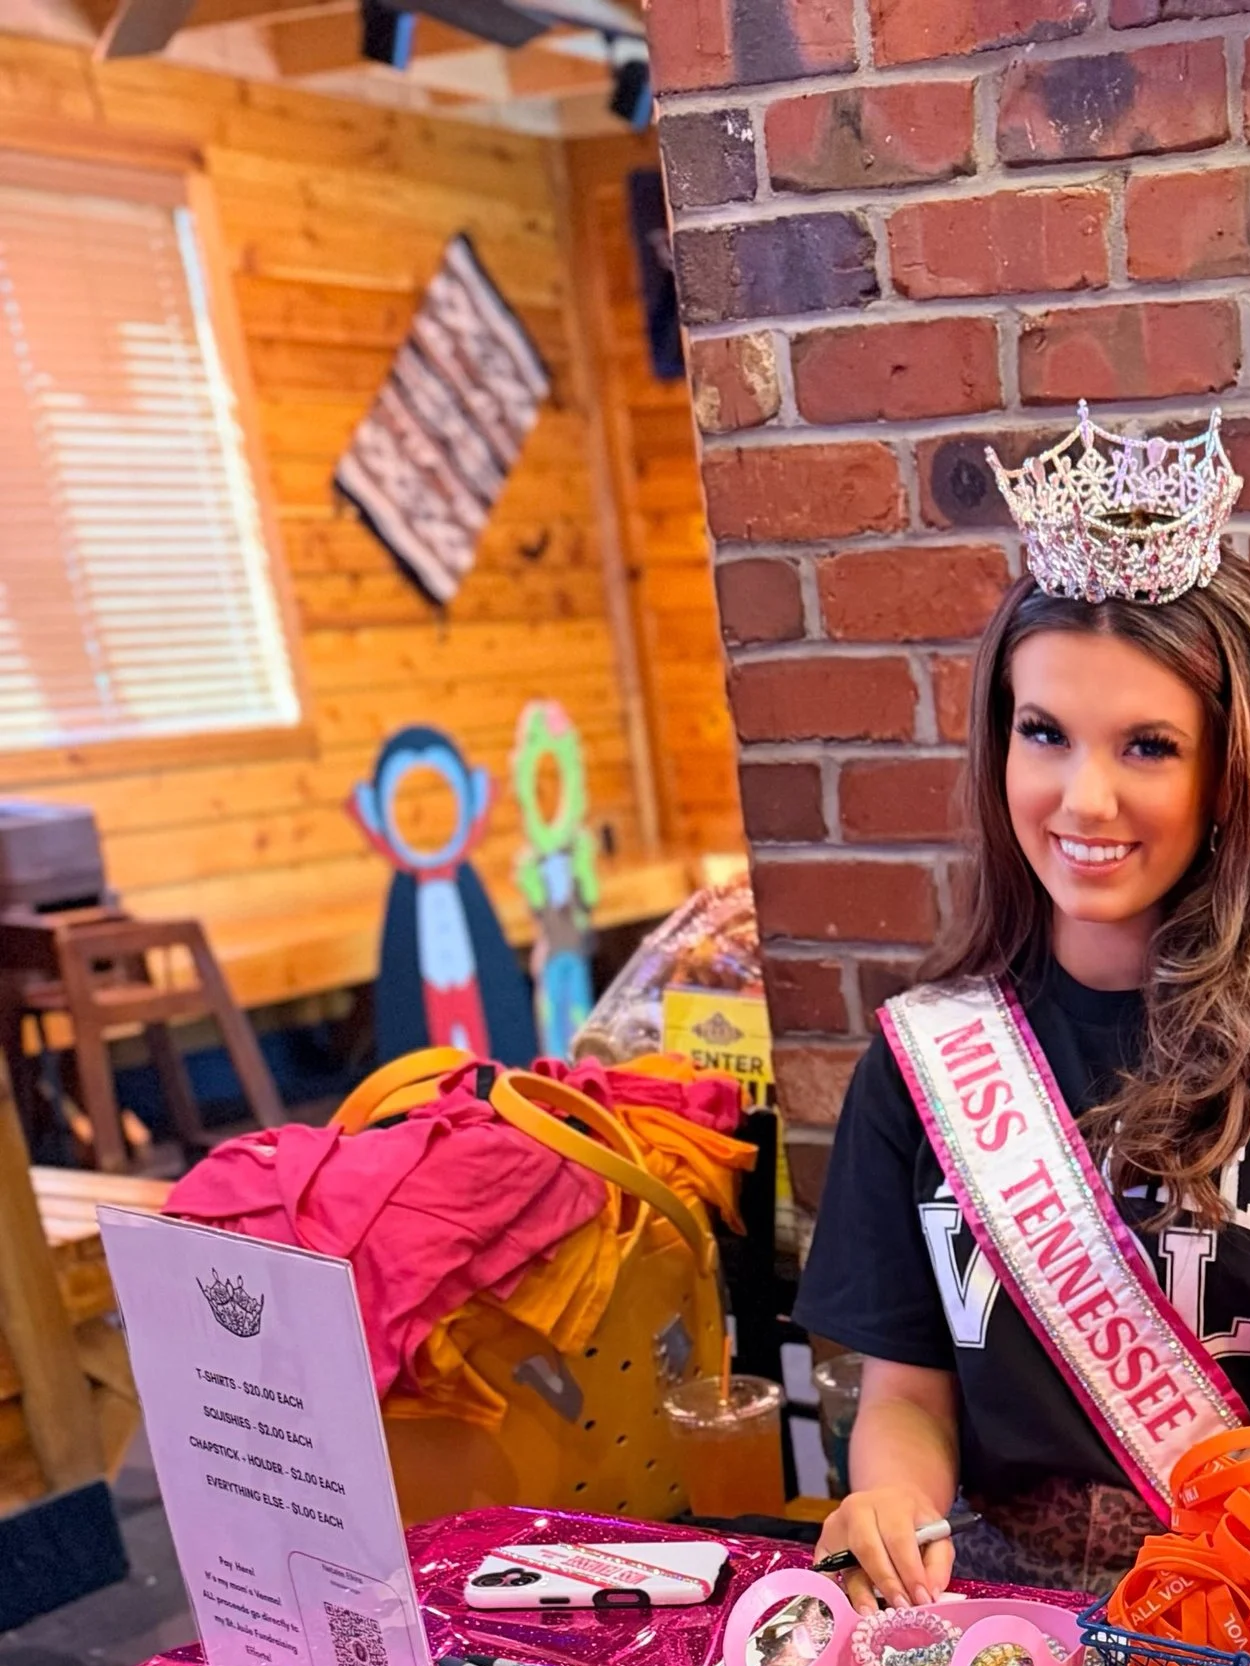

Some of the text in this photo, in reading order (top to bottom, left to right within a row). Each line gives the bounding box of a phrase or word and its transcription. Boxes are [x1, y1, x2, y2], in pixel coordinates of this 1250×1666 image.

[691, 1050, 764, 1076] ENTER
[934, 1018, 1029, 1153] MISS
[1000, 1158, 1199, 1445] TENNESSEE
[195, 1368, 236, 1390] T-SHIRTS
[243, 1382, 275, 1401] $20.00
[277, 1392, 304, 1410] EACH
[203, 1405, 251, 1430] SQUISHIES
[258, 1422, 285, 1441] $2.00
[286, 1431, 313, 1449] EACH
[189, 1436, 240, 1461] CHAPSTICK
[247, 1454, 284, 1475] HOLDER
[290, 1468, 317, 1486] $2.00
[319, 1477, 346, 1495] EACH
[206, 1474, 261, 1502] EVERYTHING
[262, 1493, 285, 1510] ELSE
[291, 1502, 316, 1520] $1.00
[317, 1511, 344, 1530] EACH
[1130, 1576, 1194, 1626] ALL VOL
[1223, 1612, 1249, 1649] VOL
